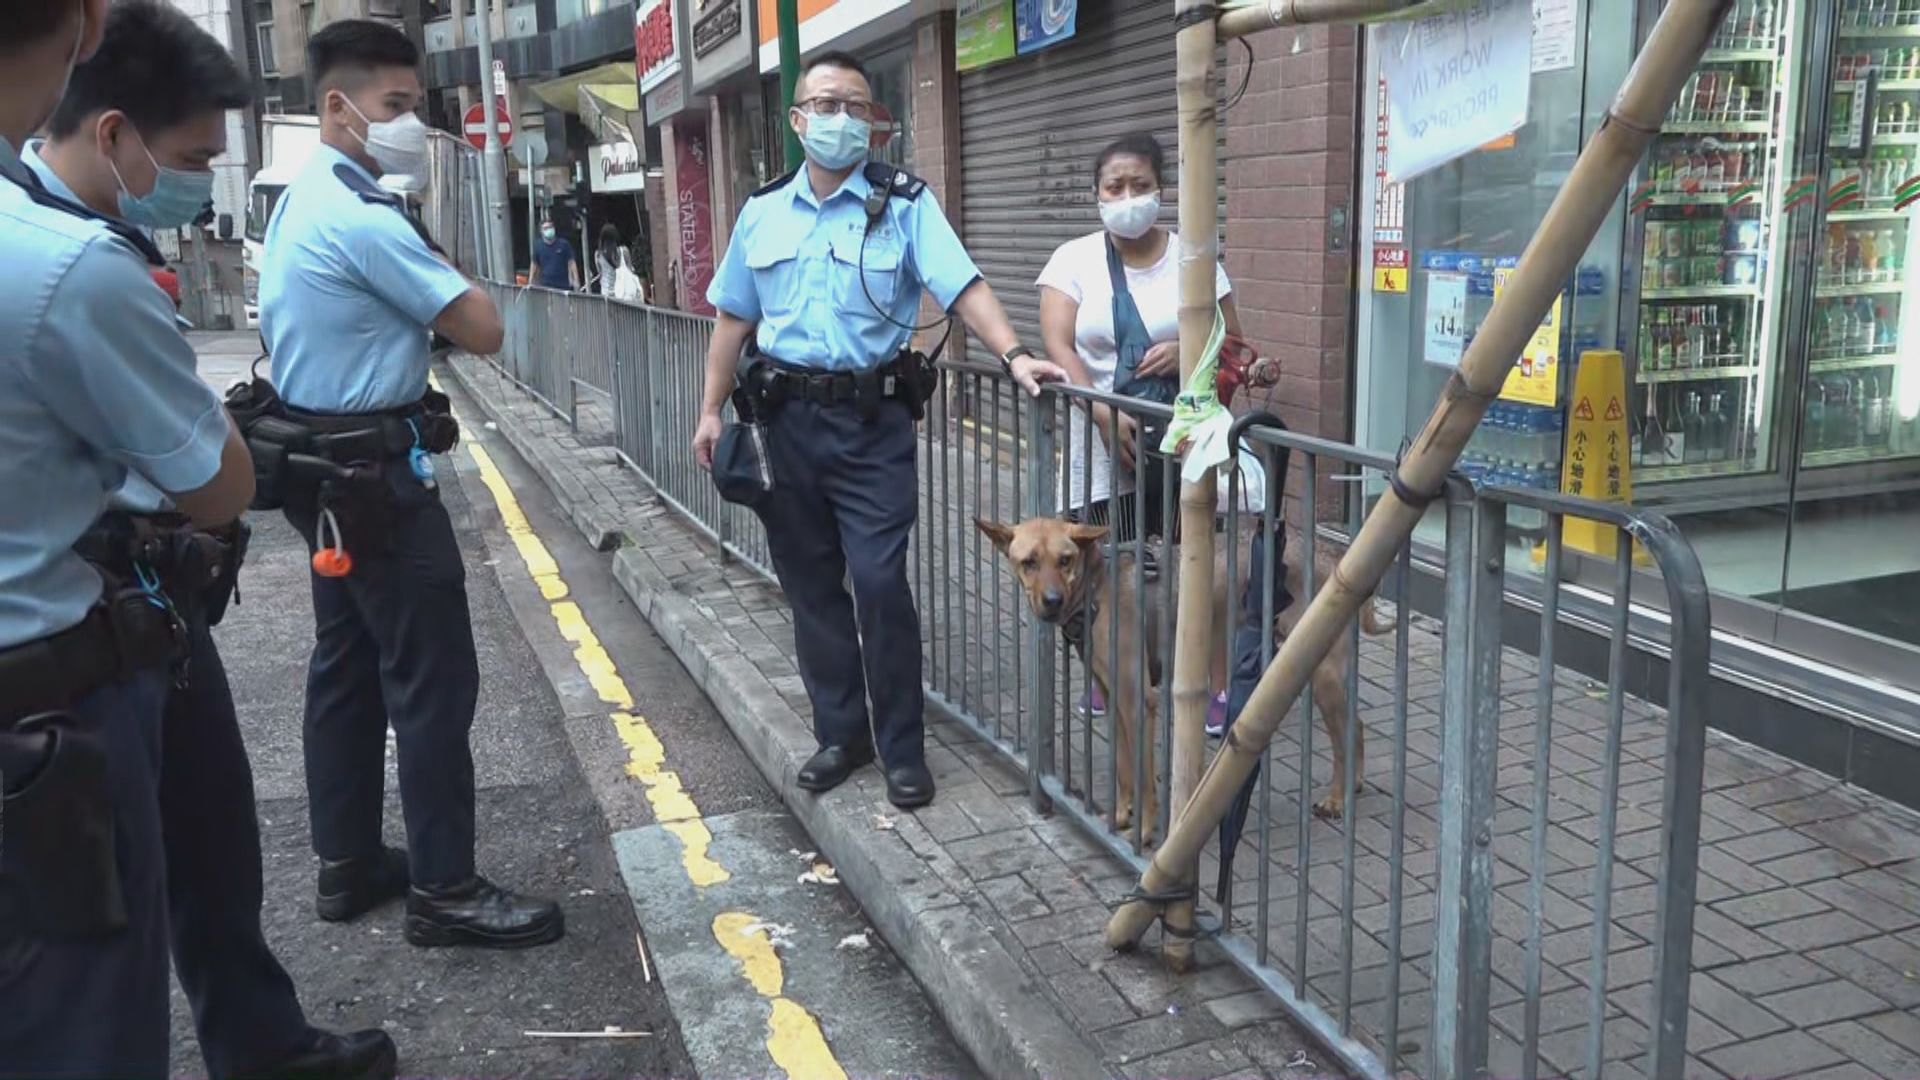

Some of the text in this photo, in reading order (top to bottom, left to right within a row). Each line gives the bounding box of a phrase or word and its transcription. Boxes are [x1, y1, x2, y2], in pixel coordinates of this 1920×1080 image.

[1569, 430, 1587, 495] 小心地滑
[1607, 430, 1621, 495] 小心地滑
